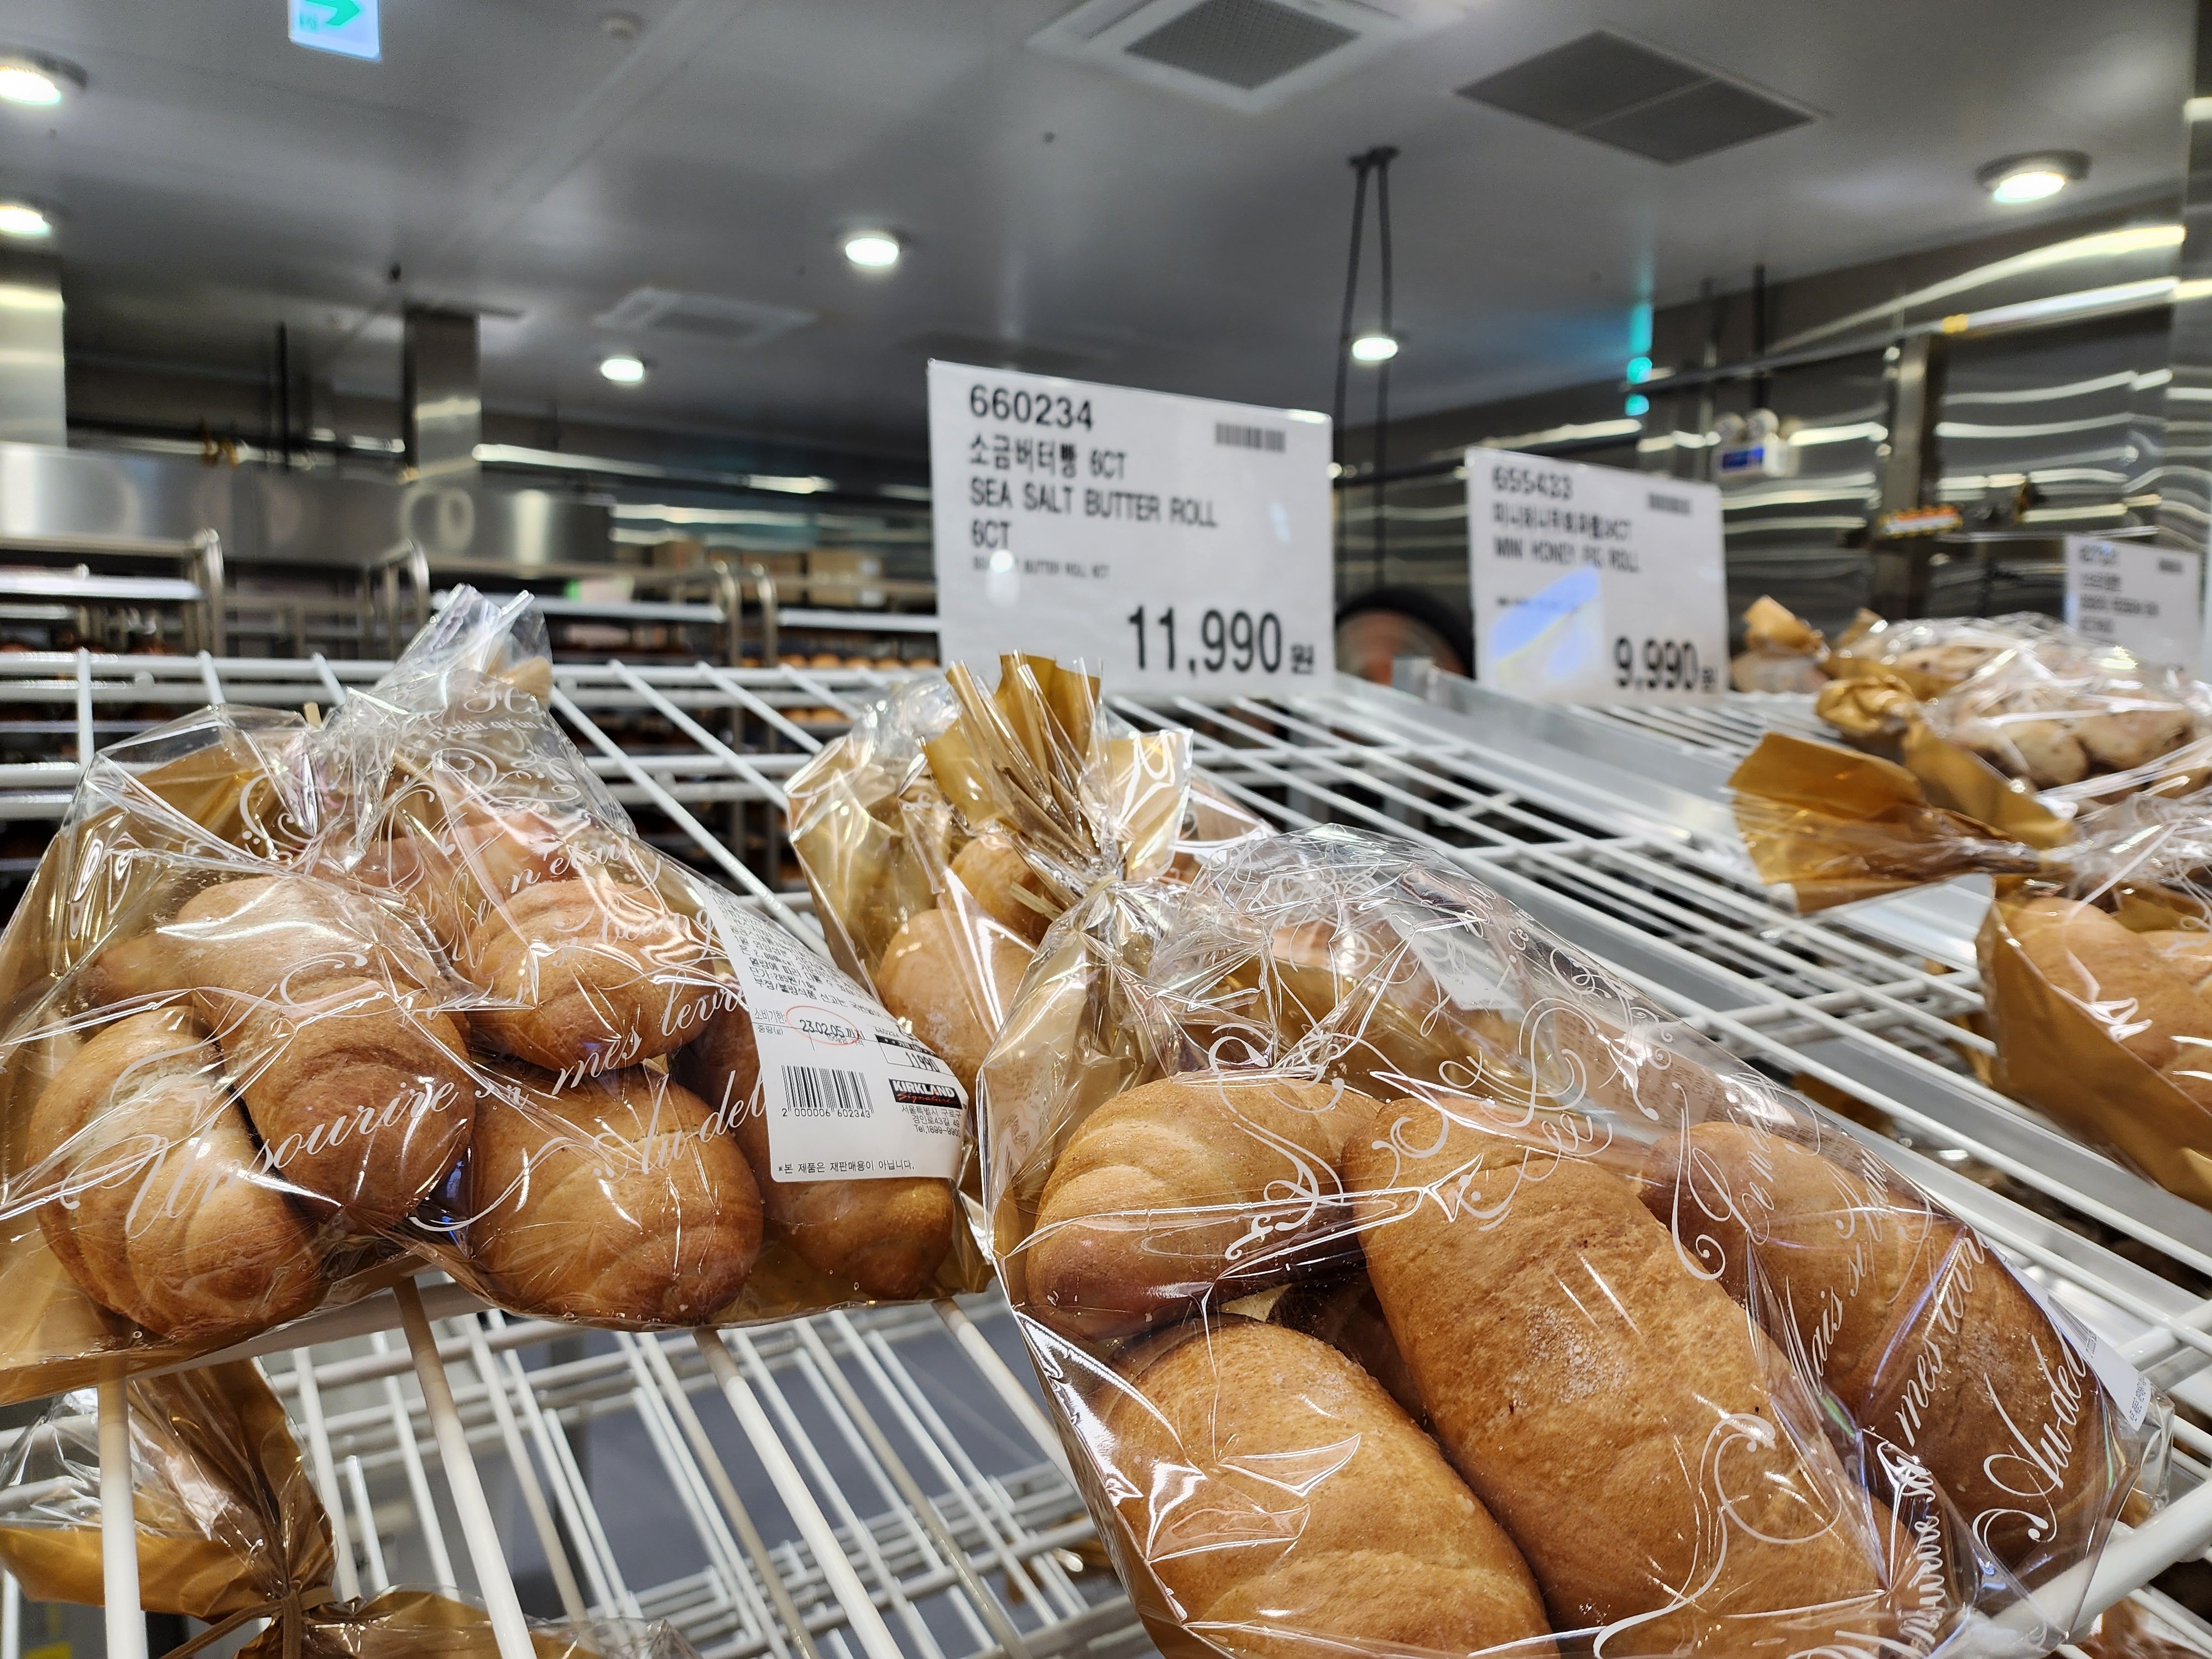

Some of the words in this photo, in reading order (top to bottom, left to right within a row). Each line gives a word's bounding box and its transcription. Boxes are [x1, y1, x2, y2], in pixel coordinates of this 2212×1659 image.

[970, 385, 1094, 430] 660234
[1089, 448, 1128, 480] 6CT
[971, 476, 1013, 508] SEA
[1024, 481, 1074, 515] SALT
[1084, 487, 1161, 524] BUTTER
[1171, 497, 1218, 529] ROLL
[972, 519, 1011, 549] 6CT
[1129, 604, 1282, 676] 11,990
[1291, 644, 1314, 675] 원
[1614, 636, 1698, 691] 9,990
[551, 1029, 643, 1095] mes
[905, 1051, 940, 1073] 11990
[892, 1079, 956, 1098] KIRKLAND
[896, 1091, 954, 1104] Signature
[781, 1108, 788, 1117] 2
[794, 1108, 831, 1117] 000006
[837, 1108, 871, 1118] 602343
[901, 1104, 939, 1117] 서울특별시
[941, 1108, 962, 1119] 구로구
[912, 1114, 950, 1127] 경인로43길
[798, 1161, 826, 1173] 제품은
[830, 1160, 874, 1172] 재판매용이
[1896, 1334, 1943, 1447] mes
[1984, 1321, 2087, 1498] Au-del
